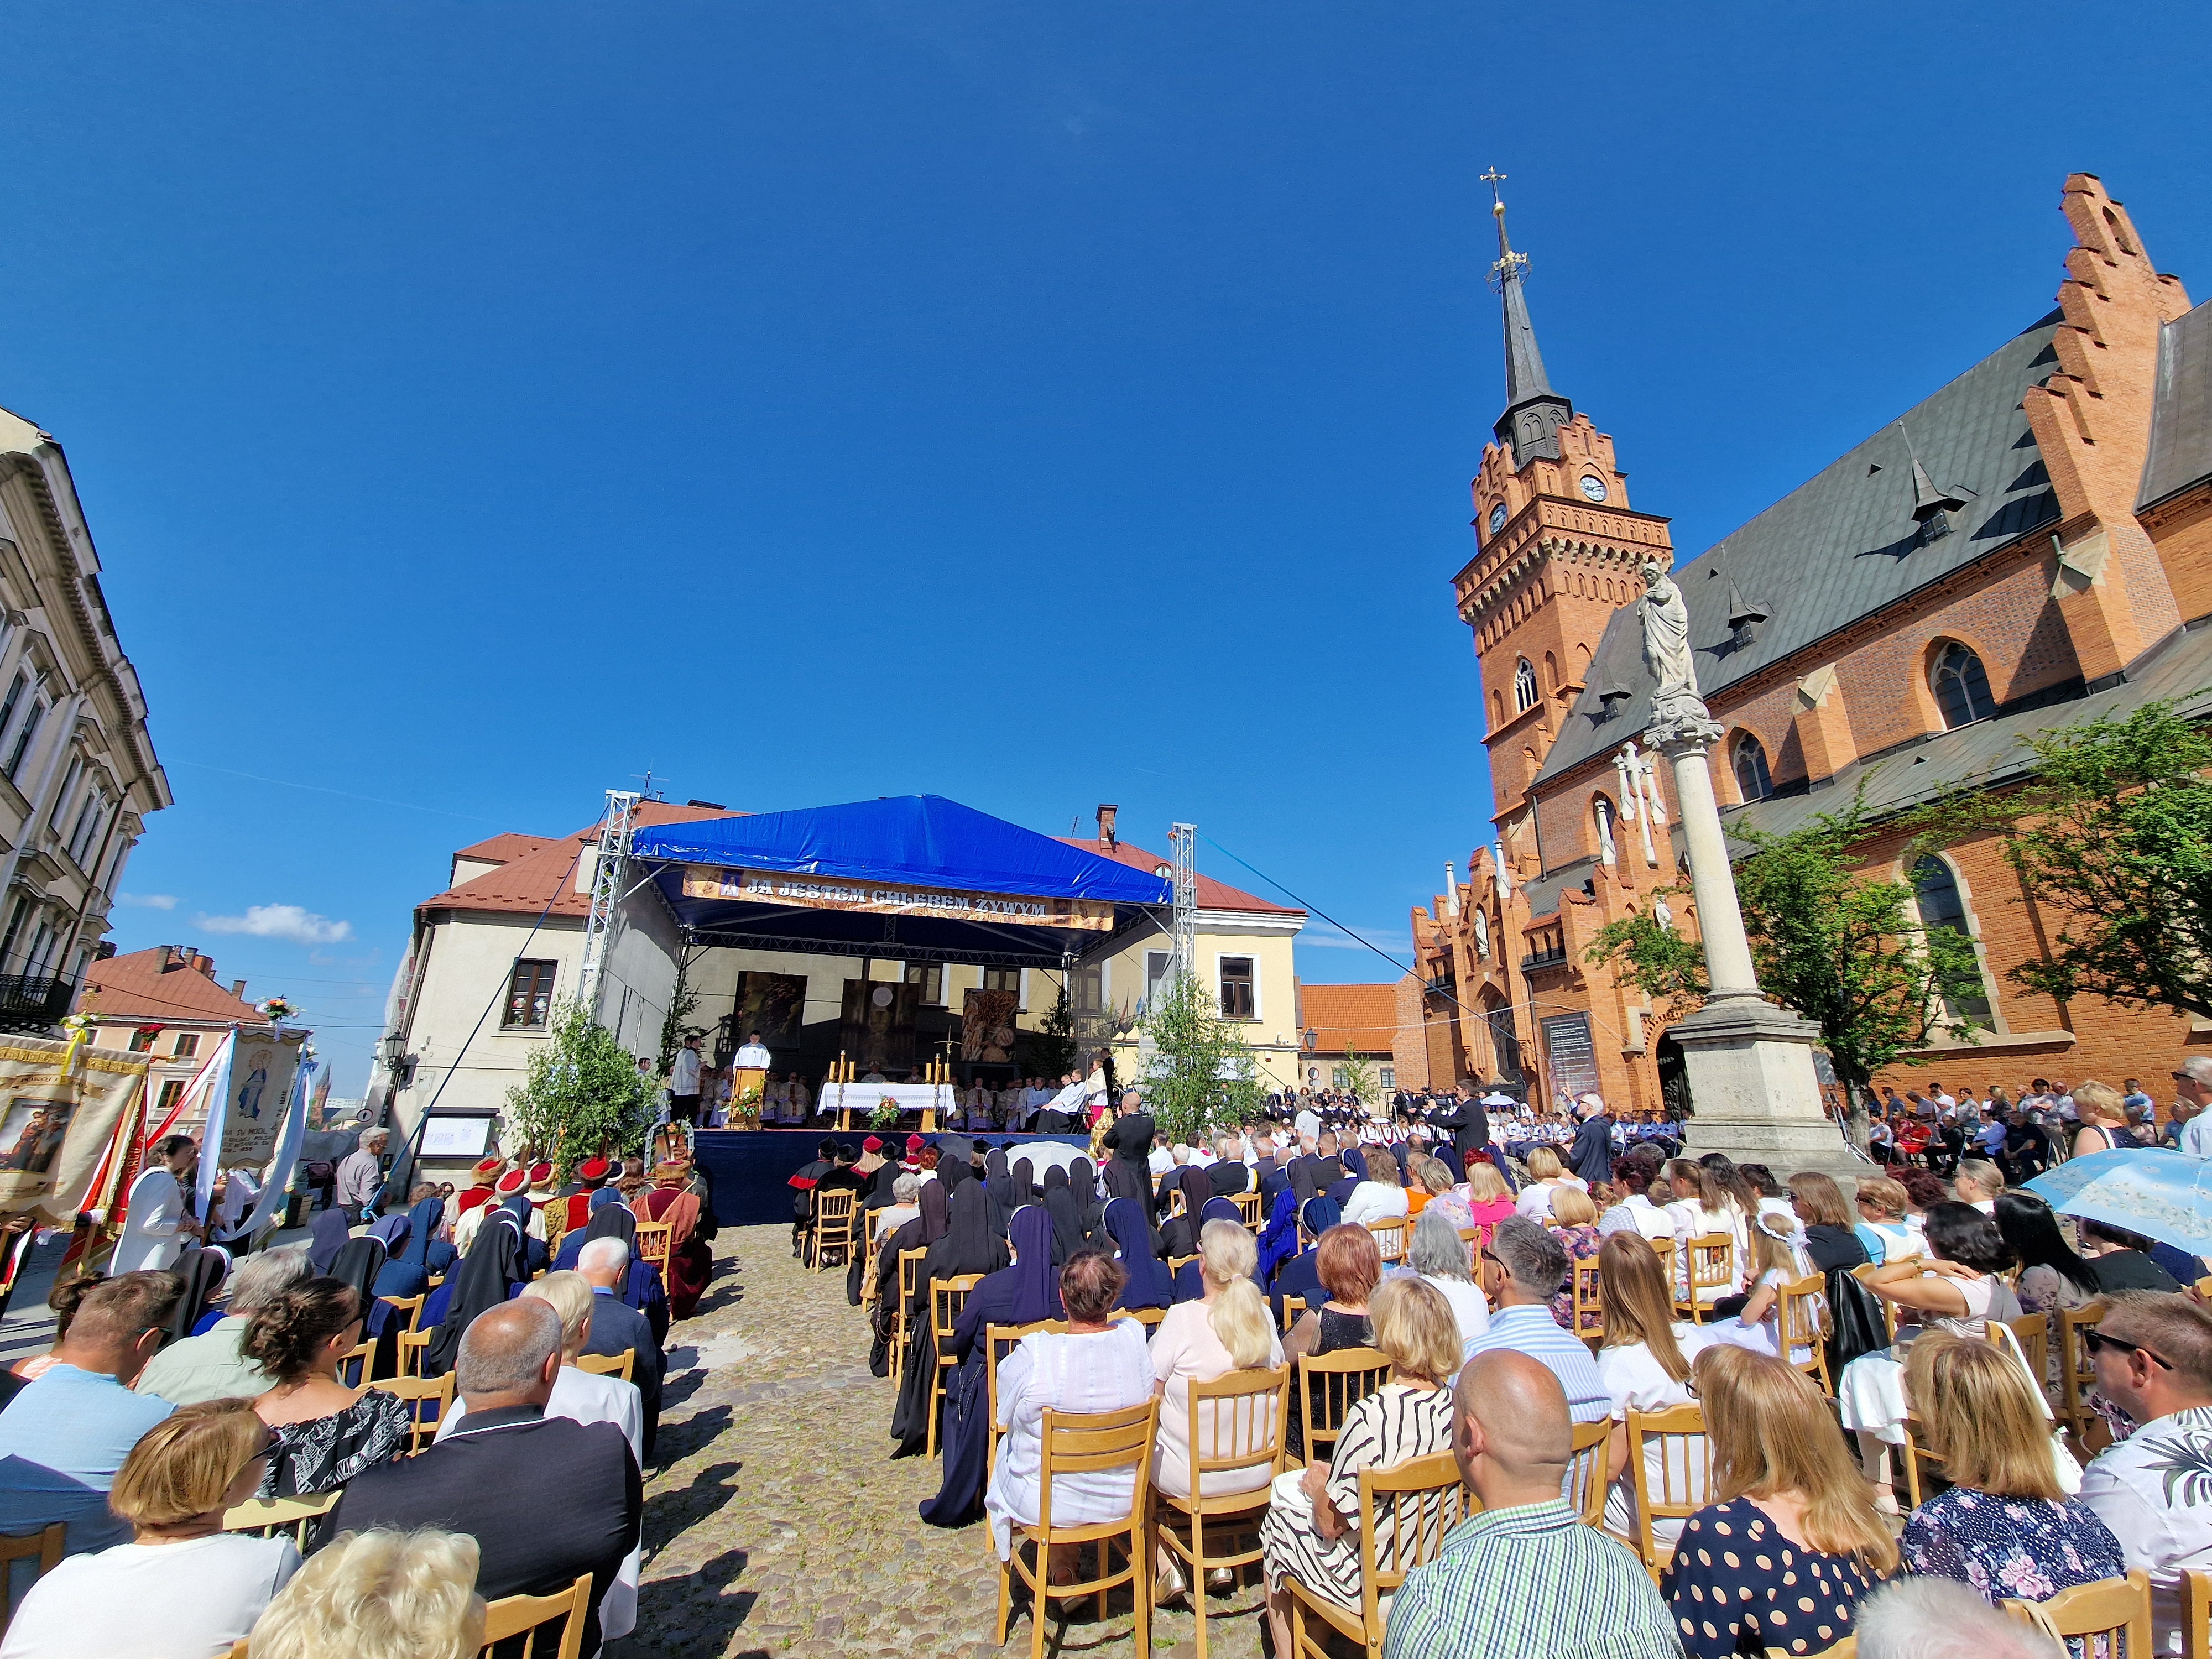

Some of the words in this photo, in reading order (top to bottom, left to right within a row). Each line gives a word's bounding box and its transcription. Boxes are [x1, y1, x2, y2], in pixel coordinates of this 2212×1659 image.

[746, 878, 774, 895] JA
[778, 881, 866, 903] JESTEM
[872, 890, 971, 911] CHLEBEM
[974, 894, 1046, 918] ŻYWYM
